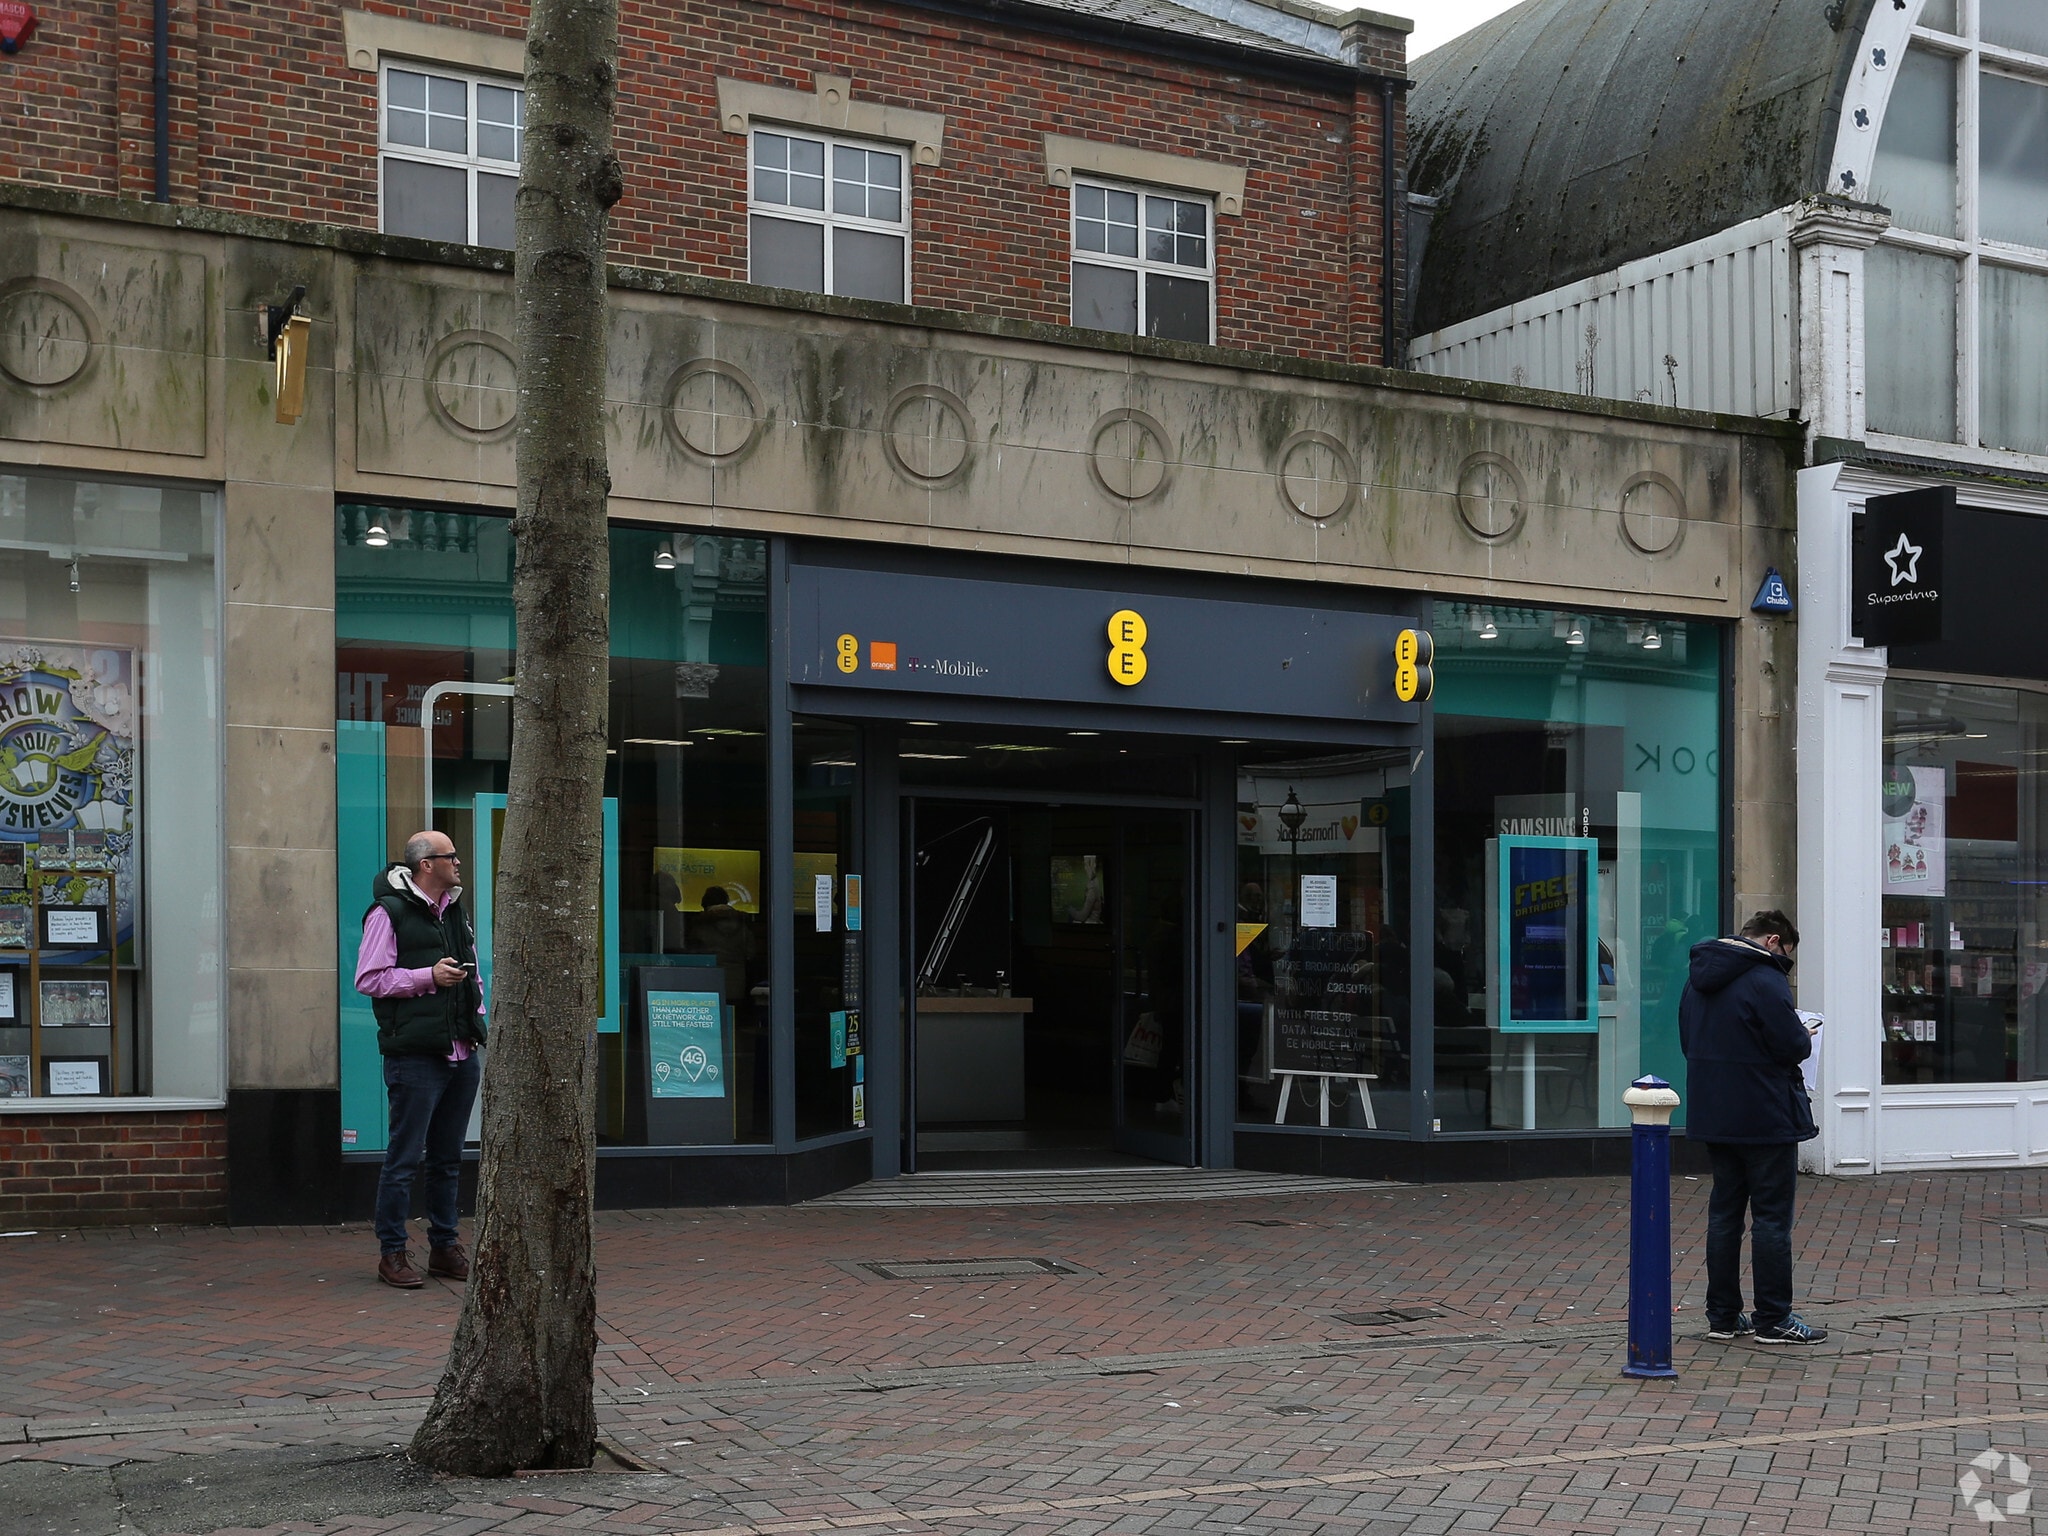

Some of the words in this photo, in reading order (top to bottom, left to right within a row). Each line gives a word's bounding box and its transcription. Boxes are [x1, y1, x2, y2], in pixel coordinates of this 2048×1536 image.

[1767, 596, 1789, 606] Chubb
[1867, 590, 1939, 605] Superdrug
[871, 662, 894, 671] orange
[12, 732, 61, 755] YOUR
[1883, 782, 1911, 796] NEW
[681, 864, 716, 874] FASTER
[1515, 873, 1577, 906] FREE
[1279, 931, 1366, 952] UNLIMITED
[1305, 961, 1360, 974] BROADBAND
[1274, 976, 1322, 997] FROM
[1277, 1008, 1302, 1019] WITH
[1304, 1010, 1329, 1021] FREE
[848, 1015, 859, 1033] 25
[1281, 1024, 1306, 1035] DATA
[1310, 1026, 1341, 1037] BOOST
[1344, 1027, 1358, 1039] ON
[1286, 1037, 1299, 1049] EE
[1301, 1038, 1335, 1051] MOBILE
[1340, 1041, 1366, 1053] PLAN
[684, 1051, 703, 1065] 4G
[657, 1065, 668, 1073] 4G
